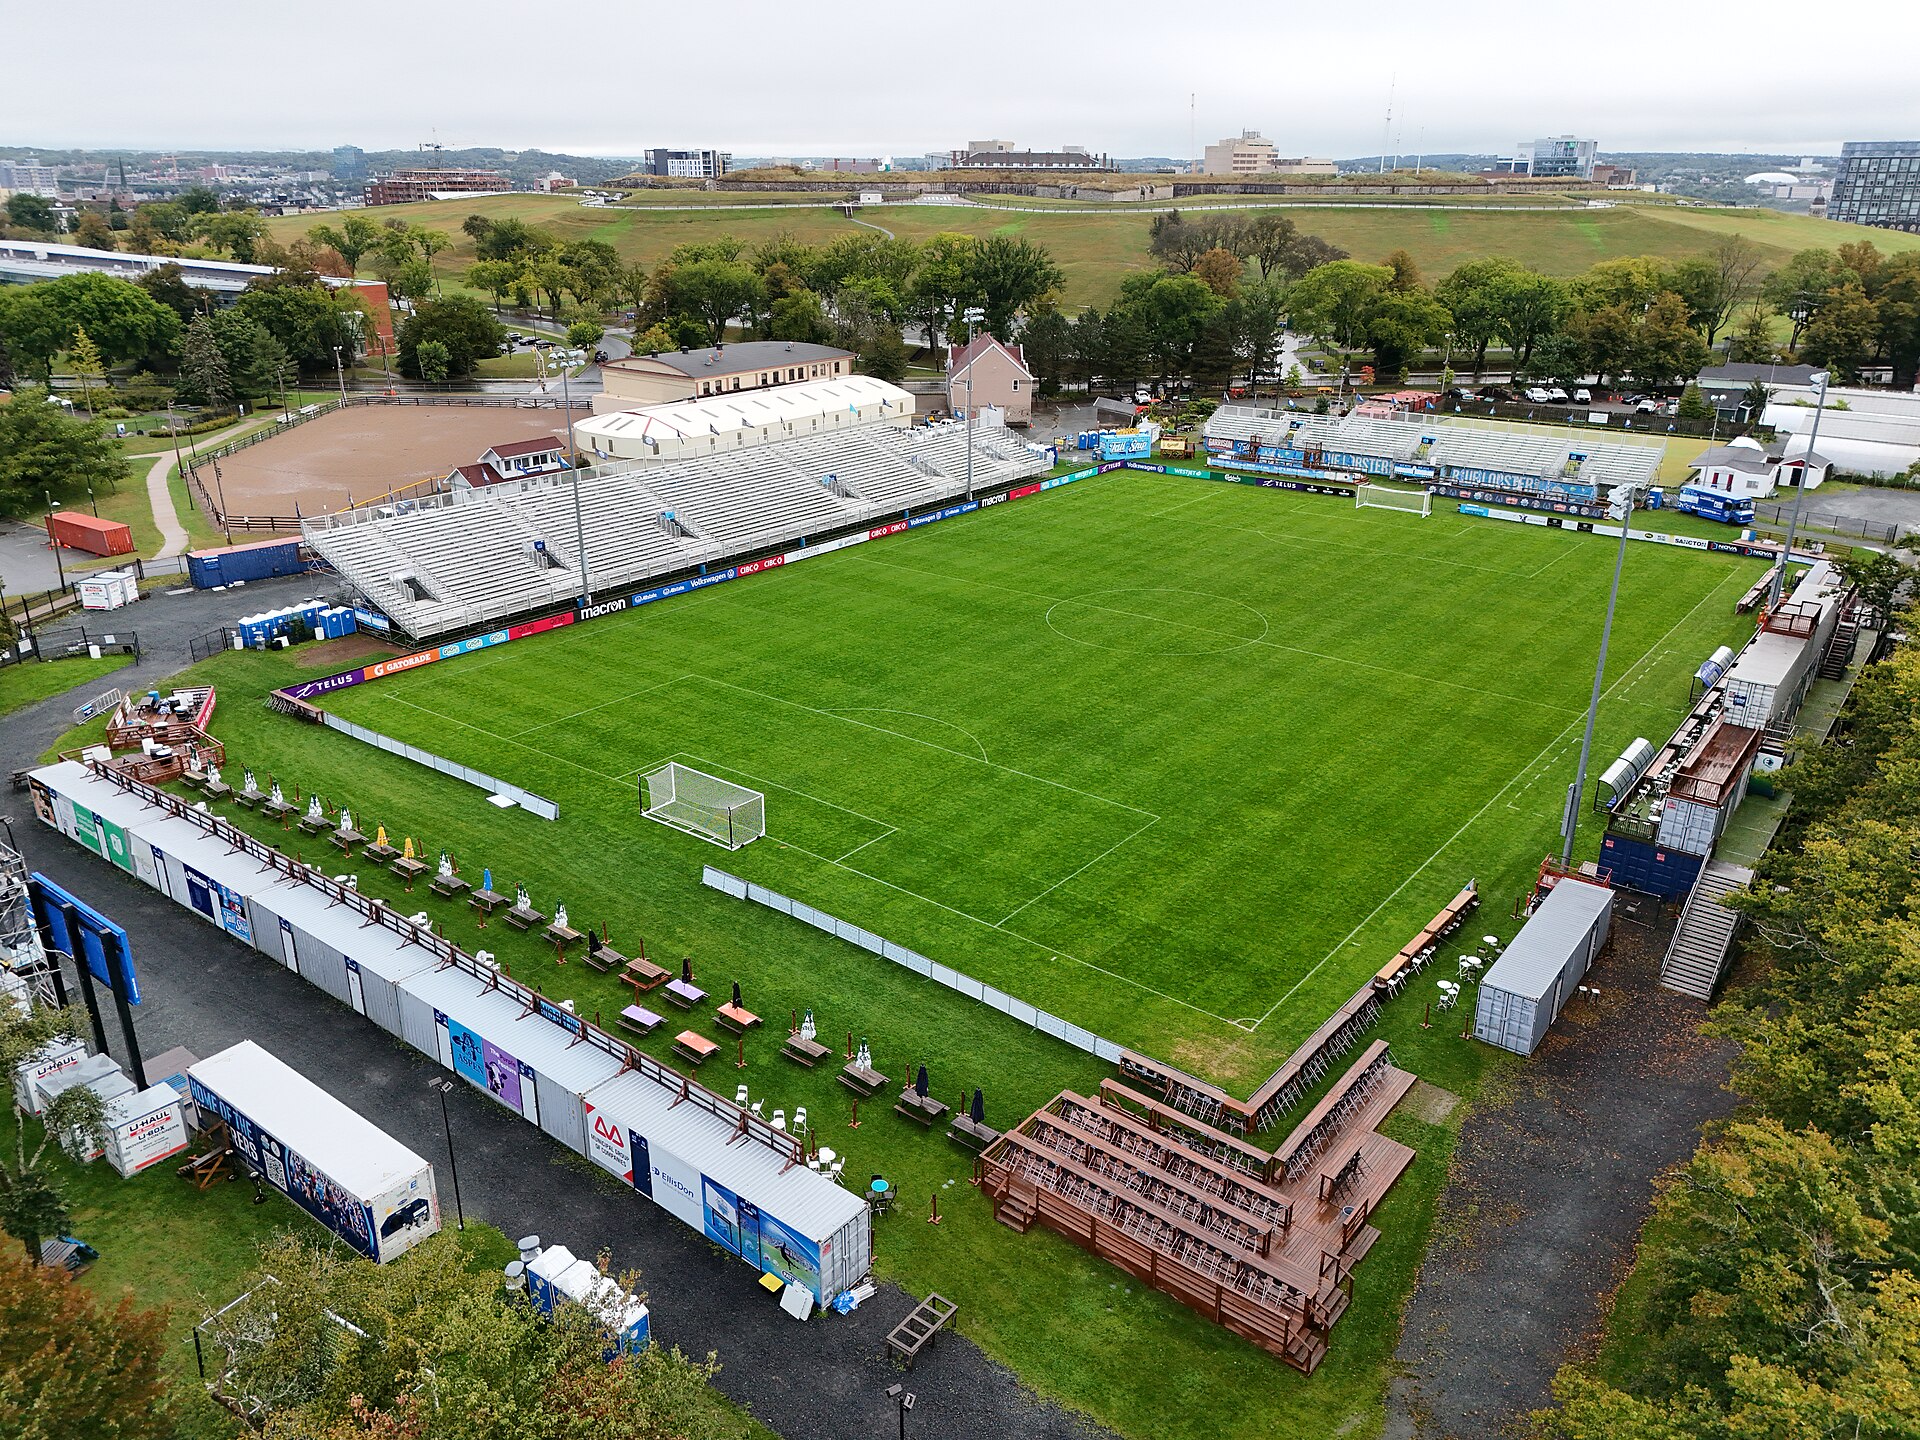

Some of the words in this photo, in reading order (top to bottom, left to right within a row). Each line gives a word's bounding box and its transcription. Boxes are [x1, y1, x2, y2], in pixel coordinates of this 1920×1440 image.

[1127, 461, 1157, 471] Volkswagen
[1174, 468, 1197, 477] WESTJET
[1275, 481, 1297, 489] TELUS
[981, 492, 1007, 508] macron
[1718, 543, 1738, 553] NOVA
[1753, 549, 1773, 559] NOVA
[740, 565, 754, 575] CIBC
[763, 557, 778, 568] CIBC
[690, 572, 727, 588] Volkswagen
[580, 598, 627, 620] macron
[517, 622, 535, 634] one
[386, 653, 431, 672] GATORADE
[316, 674, 353, 691] TELUS
[37, 1055, 77, 1076] U-HAUL
[458, 1053, 485, 1076] ASPEN
[189, 1078, 218, 1113] HOME
[219, 1100, 233, 1123] OF
[233, 1111, 254, 1142] THE
[129, 1110, 170, 1132] U-HAUL
[138, 1124, 166, 1141] U-BOX
[590, 1133, 614, 1153] MUNICIPAL
[614, 1147, 630, 1162] GROUP
[601, 1146, 627, 1168] COMPANIES
[661, 1172, 695, 1198] EllisDon
